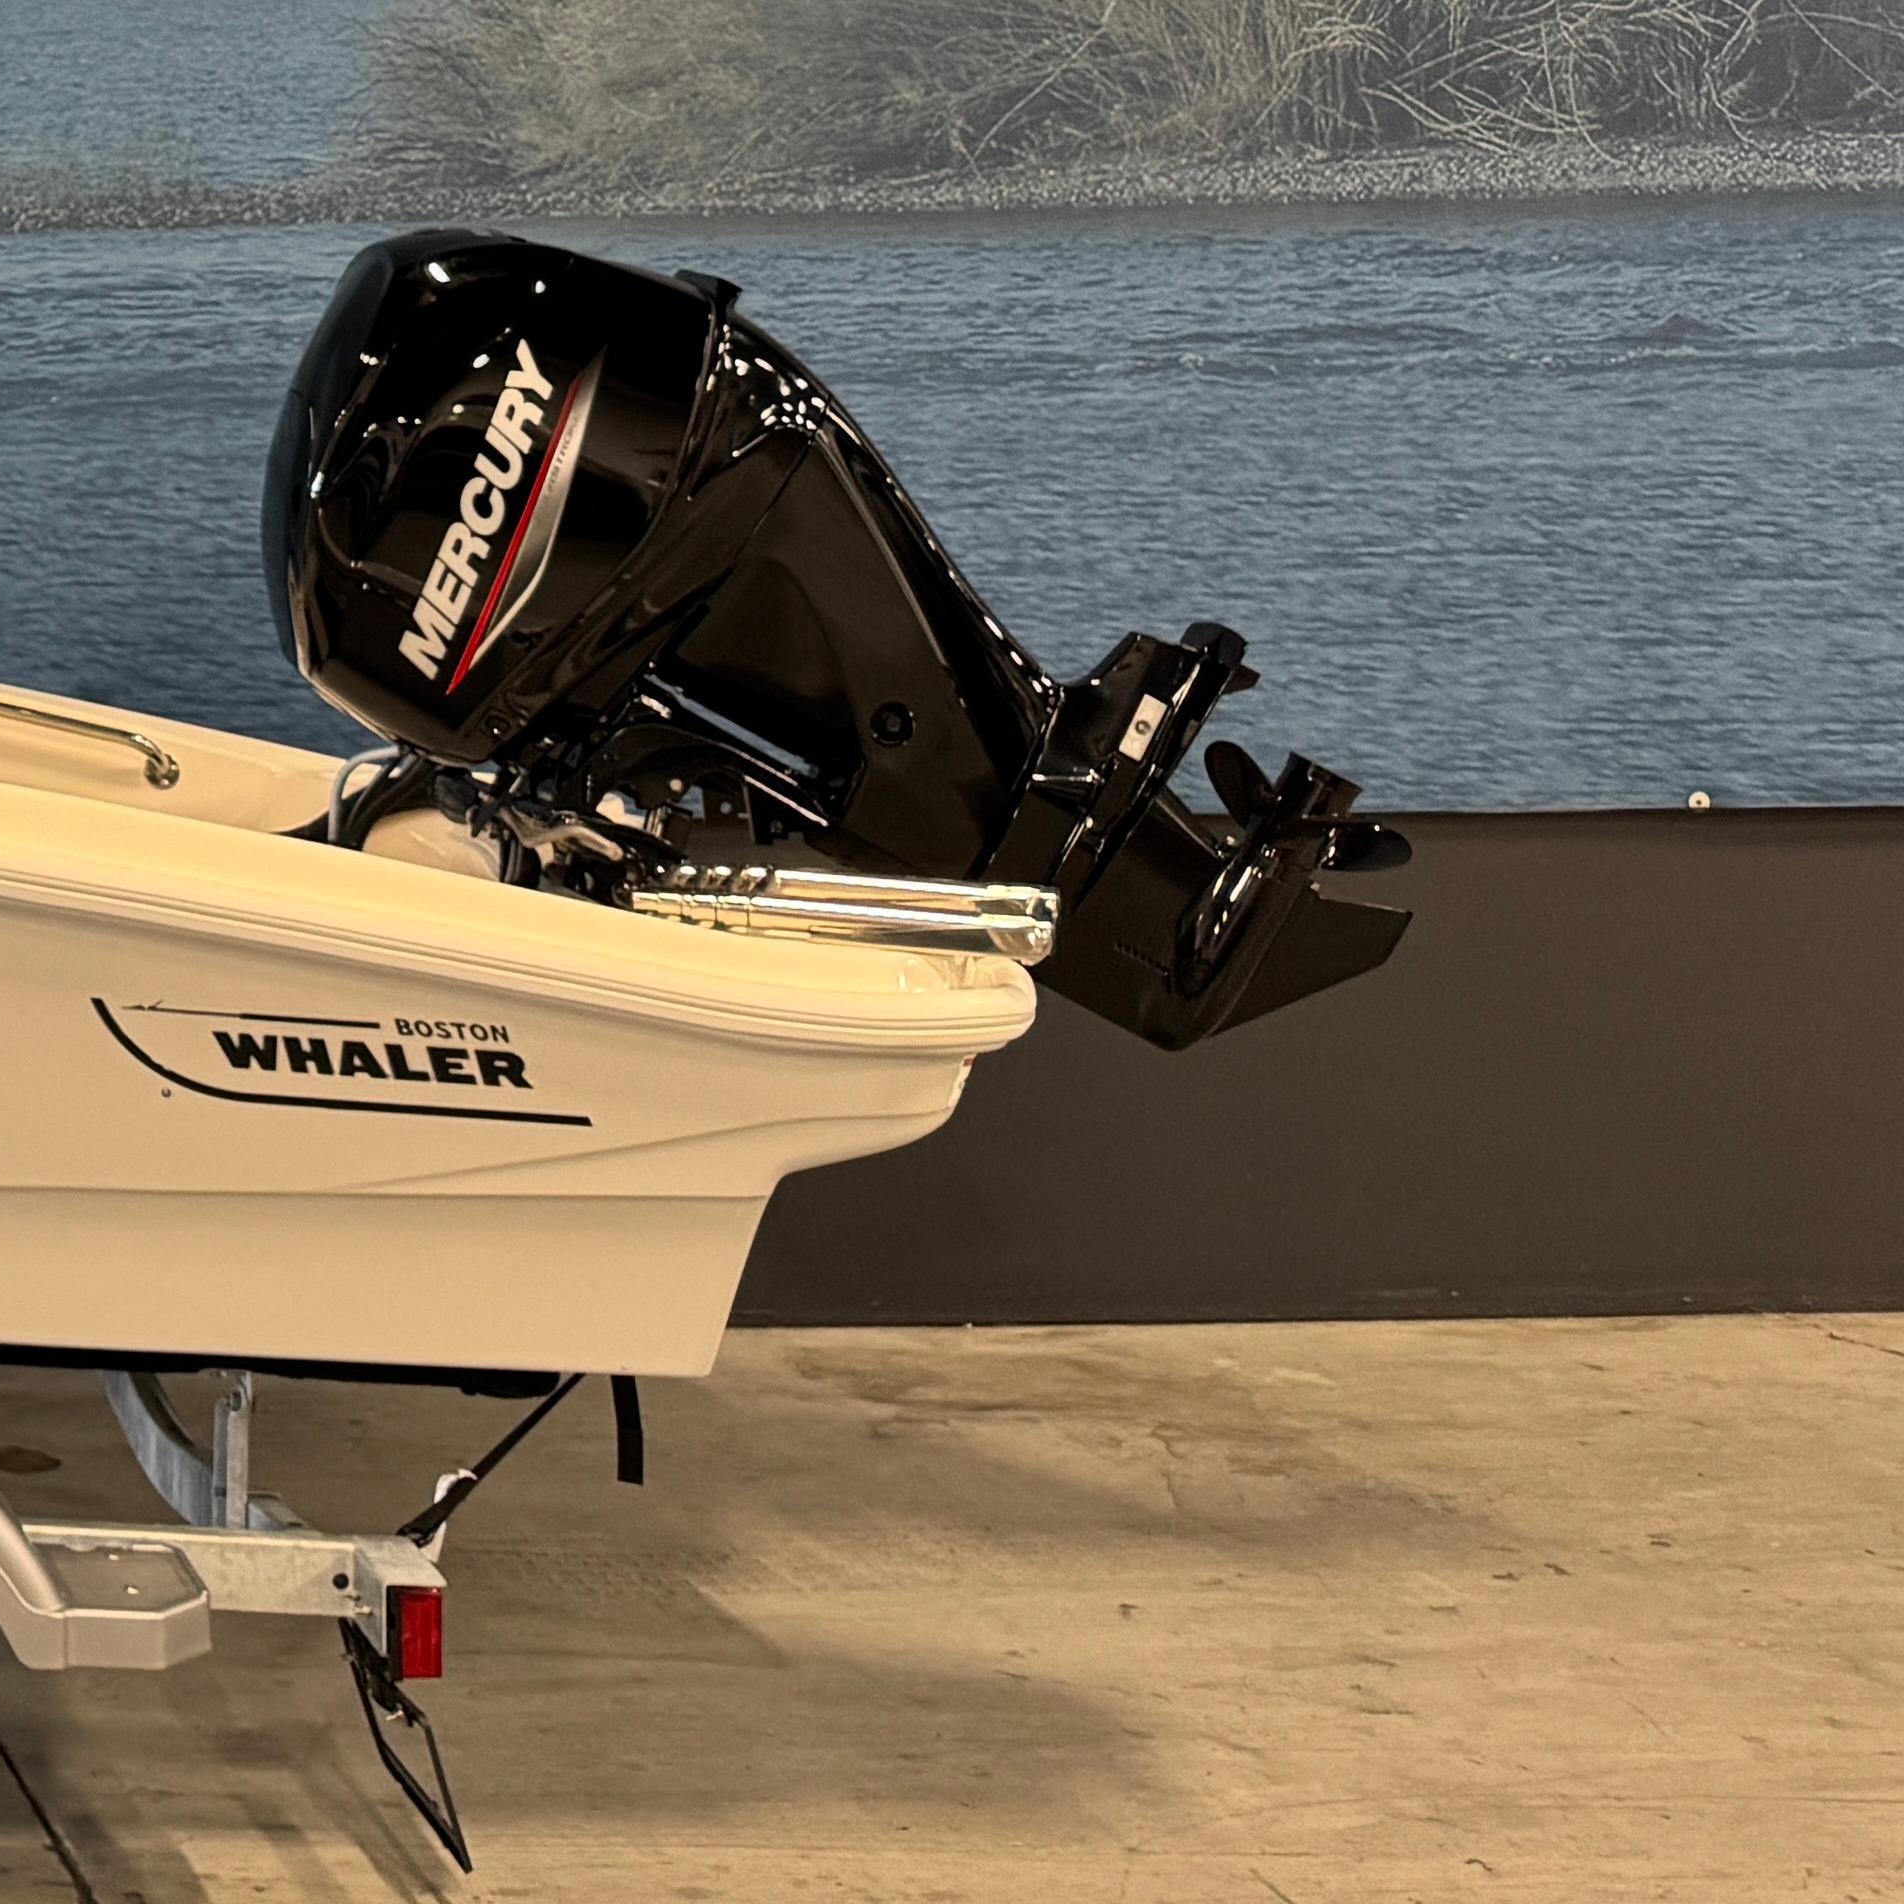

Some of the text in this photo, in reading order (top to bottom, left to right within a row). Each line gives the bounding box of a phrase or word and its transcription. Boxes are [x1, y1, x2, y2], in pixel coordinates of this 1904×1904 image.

[397, 338, 554, 680] MERCURY
[212, 1030, 534, 1090] WHALER
[394, 1018, 510, 1044] BOSTON
